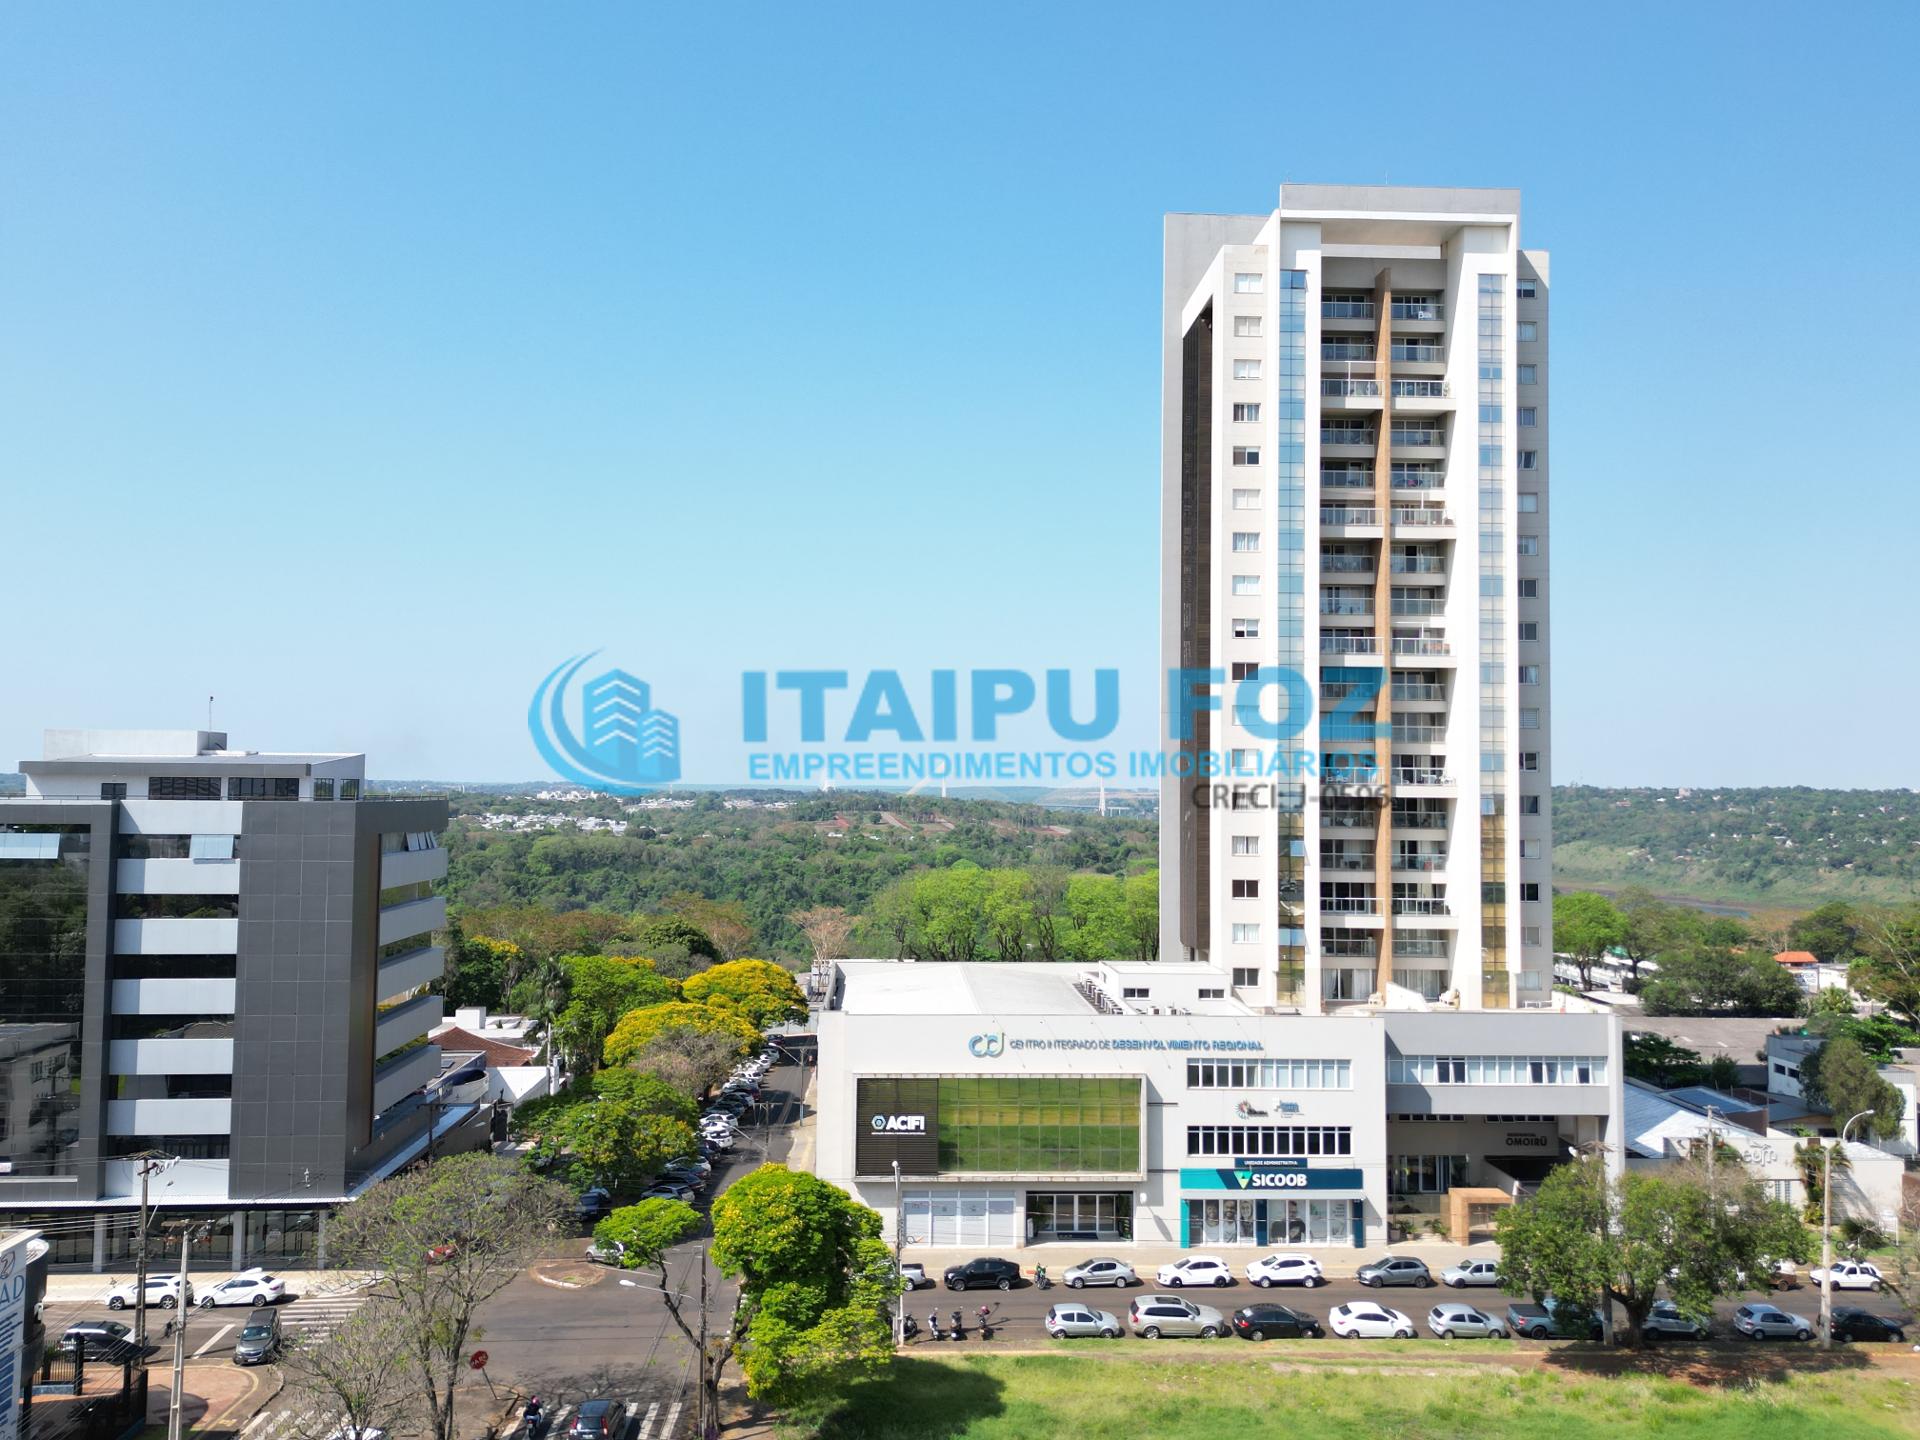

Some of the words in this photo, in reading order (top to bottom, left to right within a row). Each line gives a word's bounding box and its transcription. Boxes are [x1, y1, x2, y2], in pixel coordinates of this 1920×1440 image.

[1009, 1039, 1046, 1050] CENTRO
[1047, 1039, 1097, 1050] INTEGRADO
[1098, 1039, 1111, 1050] DE
[1112, 1039, 1211, 1051] DESENVOLVIMENTO
[1212, 1040, 1264, 1051] REGIONAL
[886, 1115, 925, 1130] ACIFI
[1252, 1173, 1307, 1187] SICOOB
